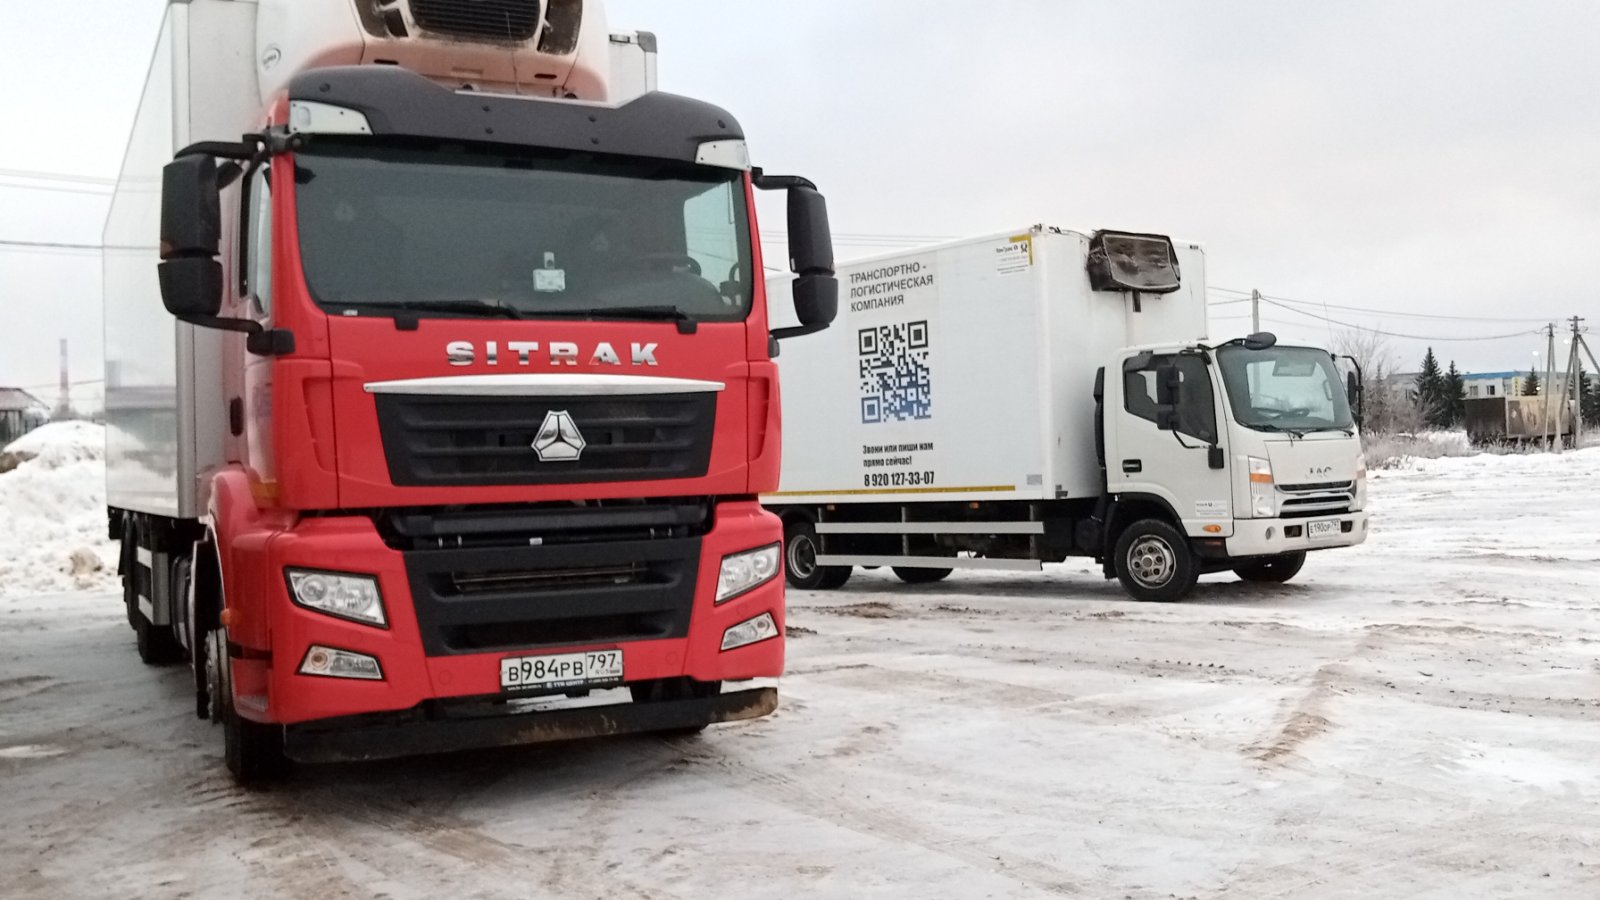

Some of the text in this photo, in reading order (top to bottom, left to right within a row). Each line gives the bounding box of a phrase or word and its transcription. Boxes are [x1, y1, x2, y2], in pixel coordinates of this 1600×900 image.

[849, 262, 920, 284] ТРАНСПОРТНО
[850, 274, 933, 298] ЛОГИСТИЧЕСКАЯ
[850, 294, 904, 312] КОМПАНИЯ
[446, 341, 658, 366] SITRAK
[884, 444, 897, 453] или
[898, 443, 918, 452] пиши
[919, 442, 933, 451] нам
[864, 471, 934, 487] 8 920 127-33-07
[588, 653, 616, 669] 797
